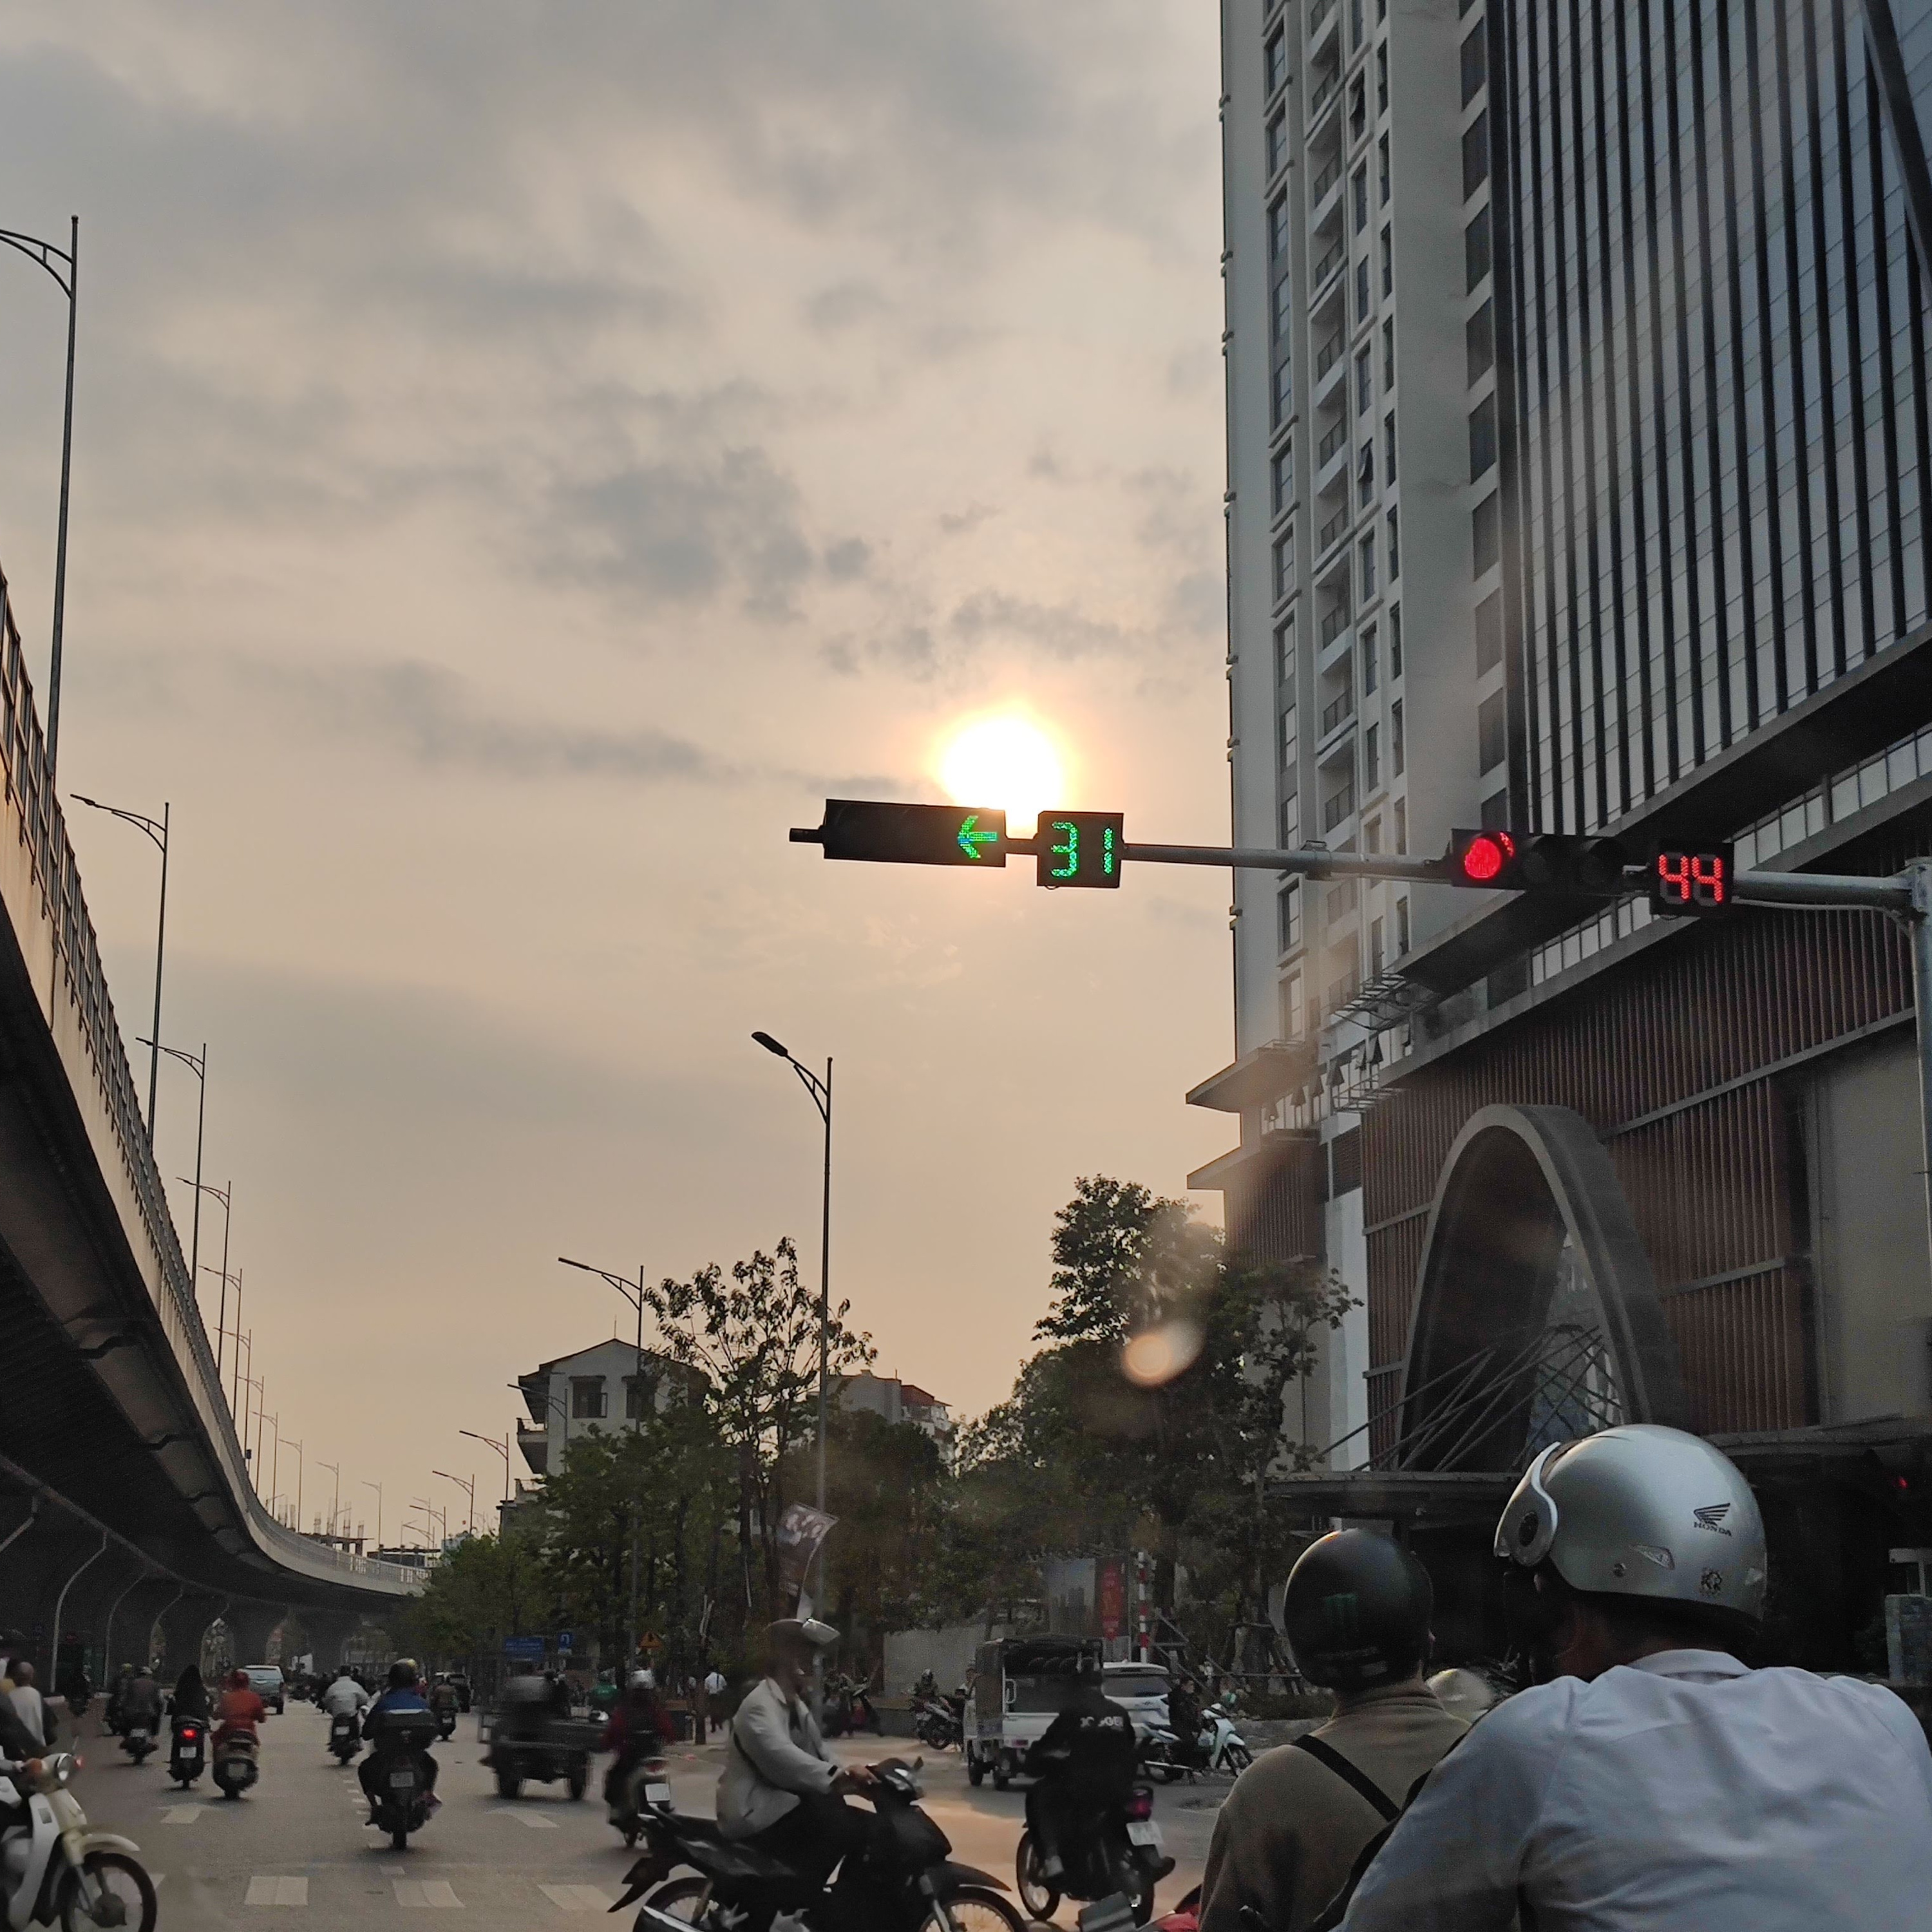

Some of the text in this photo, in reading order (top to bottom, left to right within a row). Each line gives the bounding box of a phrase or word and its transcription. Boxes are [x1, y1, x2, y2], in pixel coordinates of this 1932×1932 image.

[1050, 820, 1114, 878] 31
[1658, 854, 1723, 903] 44
[1694, 1521, 1732, 1537] HONDA
